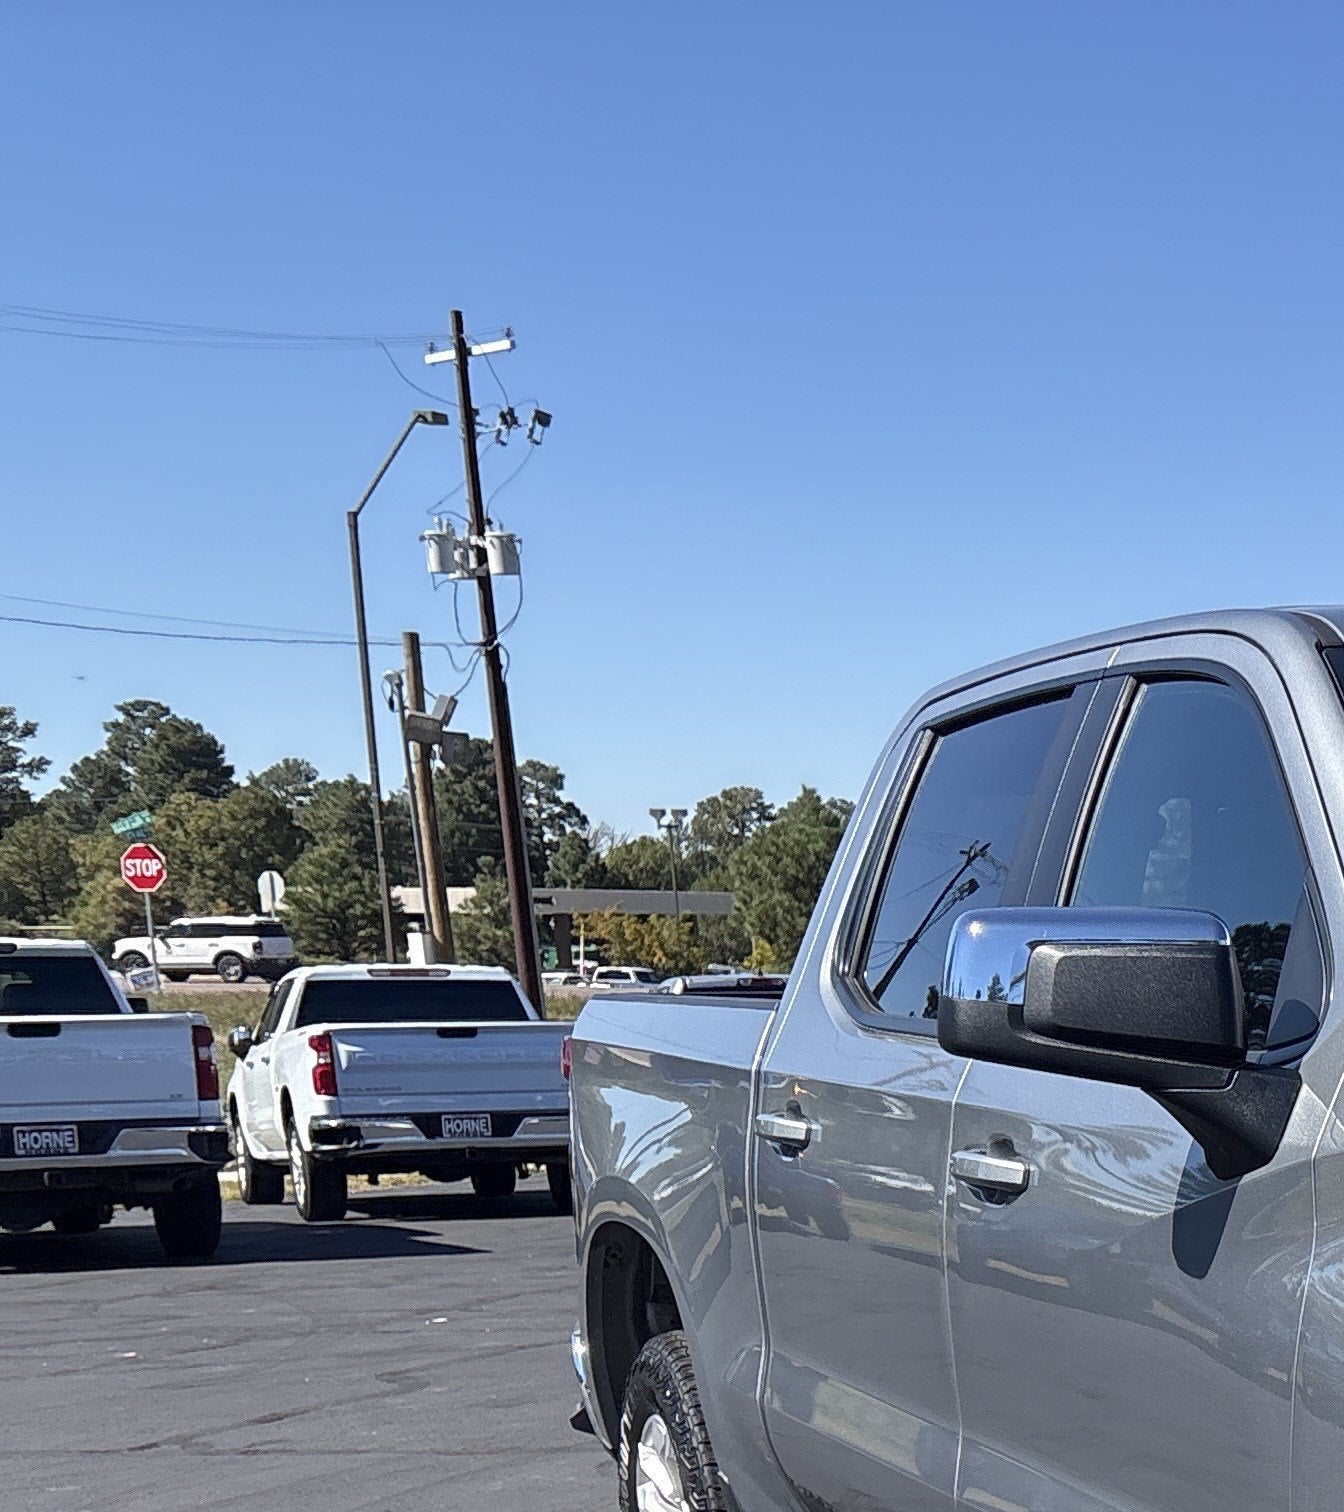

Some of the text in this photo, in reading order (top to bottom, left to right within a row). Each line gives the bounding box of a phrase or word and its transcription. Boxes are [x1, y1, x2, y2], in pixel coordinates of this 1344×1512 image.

[125, 859, 163, 877] STOP
[445, 1117, 488, 1134] HORNE
[18, 1130, 75, 1150] HORNE
